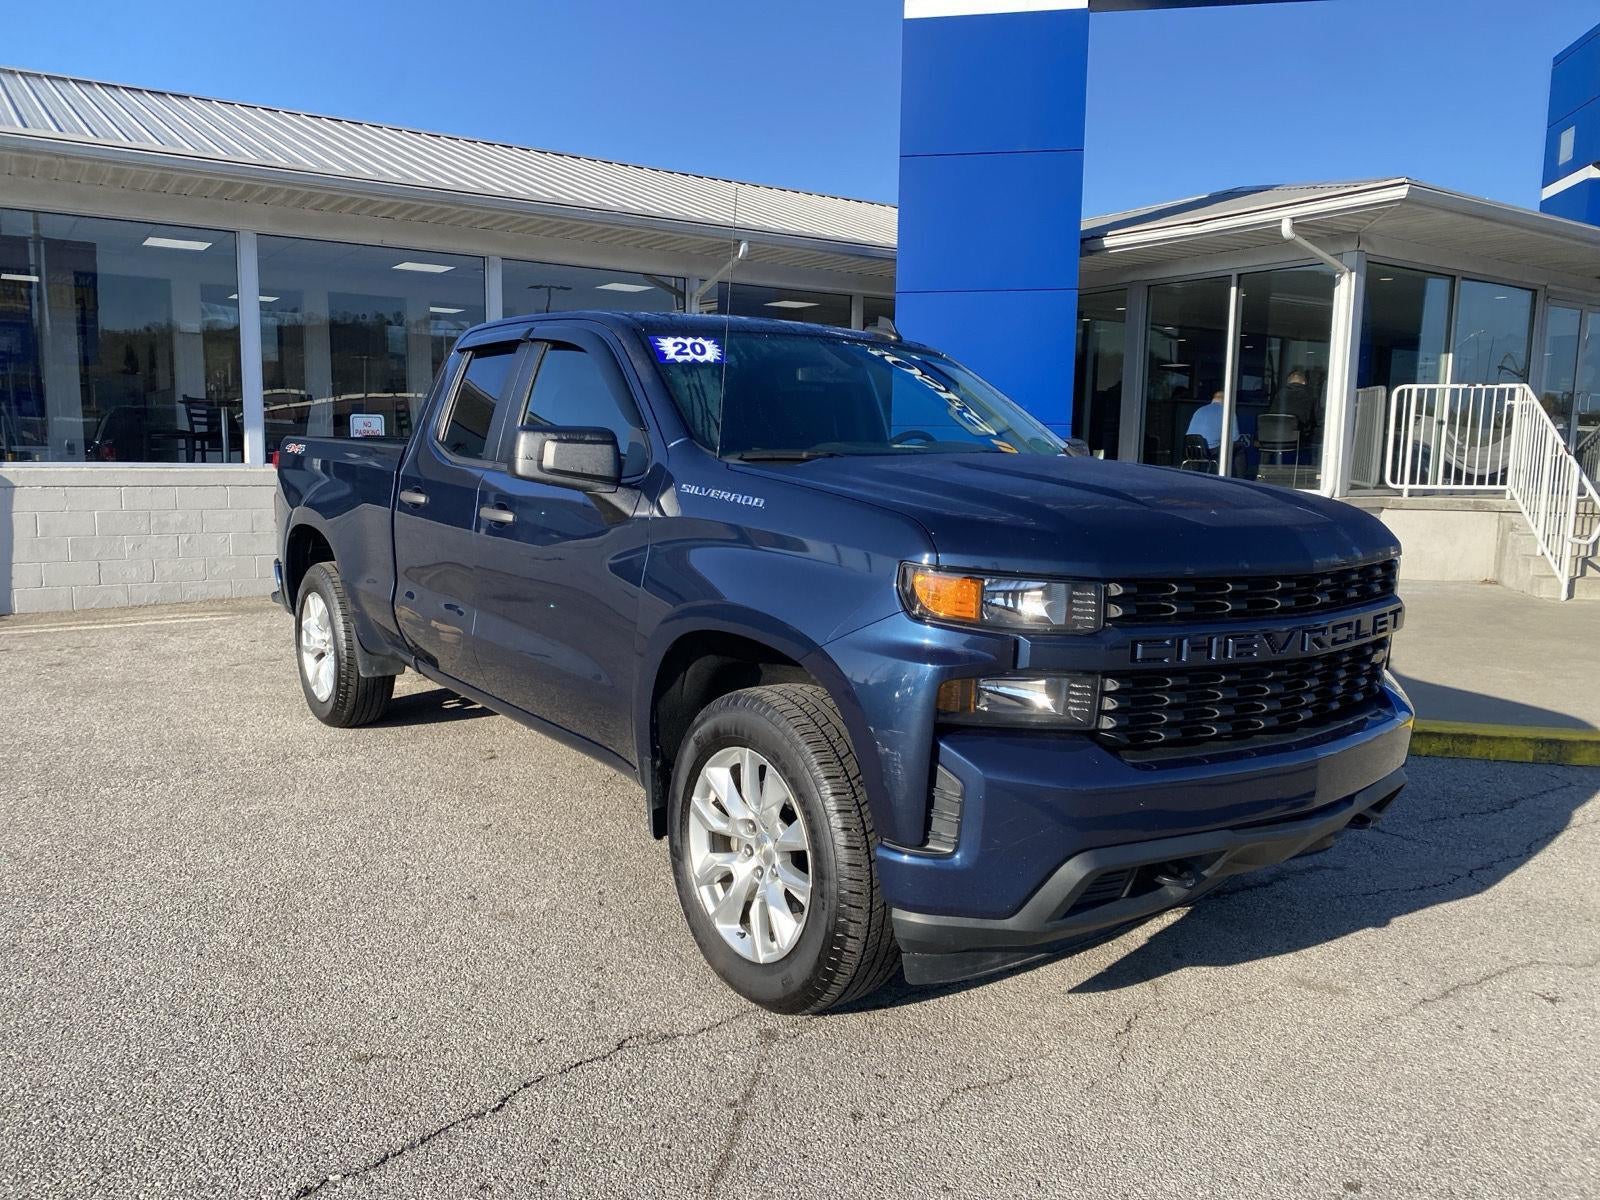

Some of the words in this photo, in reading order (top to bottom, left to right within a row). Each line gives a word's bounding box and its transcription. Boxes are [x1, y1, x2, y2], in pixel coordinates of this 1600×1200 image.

[672, 341, 707, 356] 20
[363, 420, 372, 428] NO
[680, 483, 765, 508] SILVERADO
[1130, 606, 1403, 664] CHEVROLET
